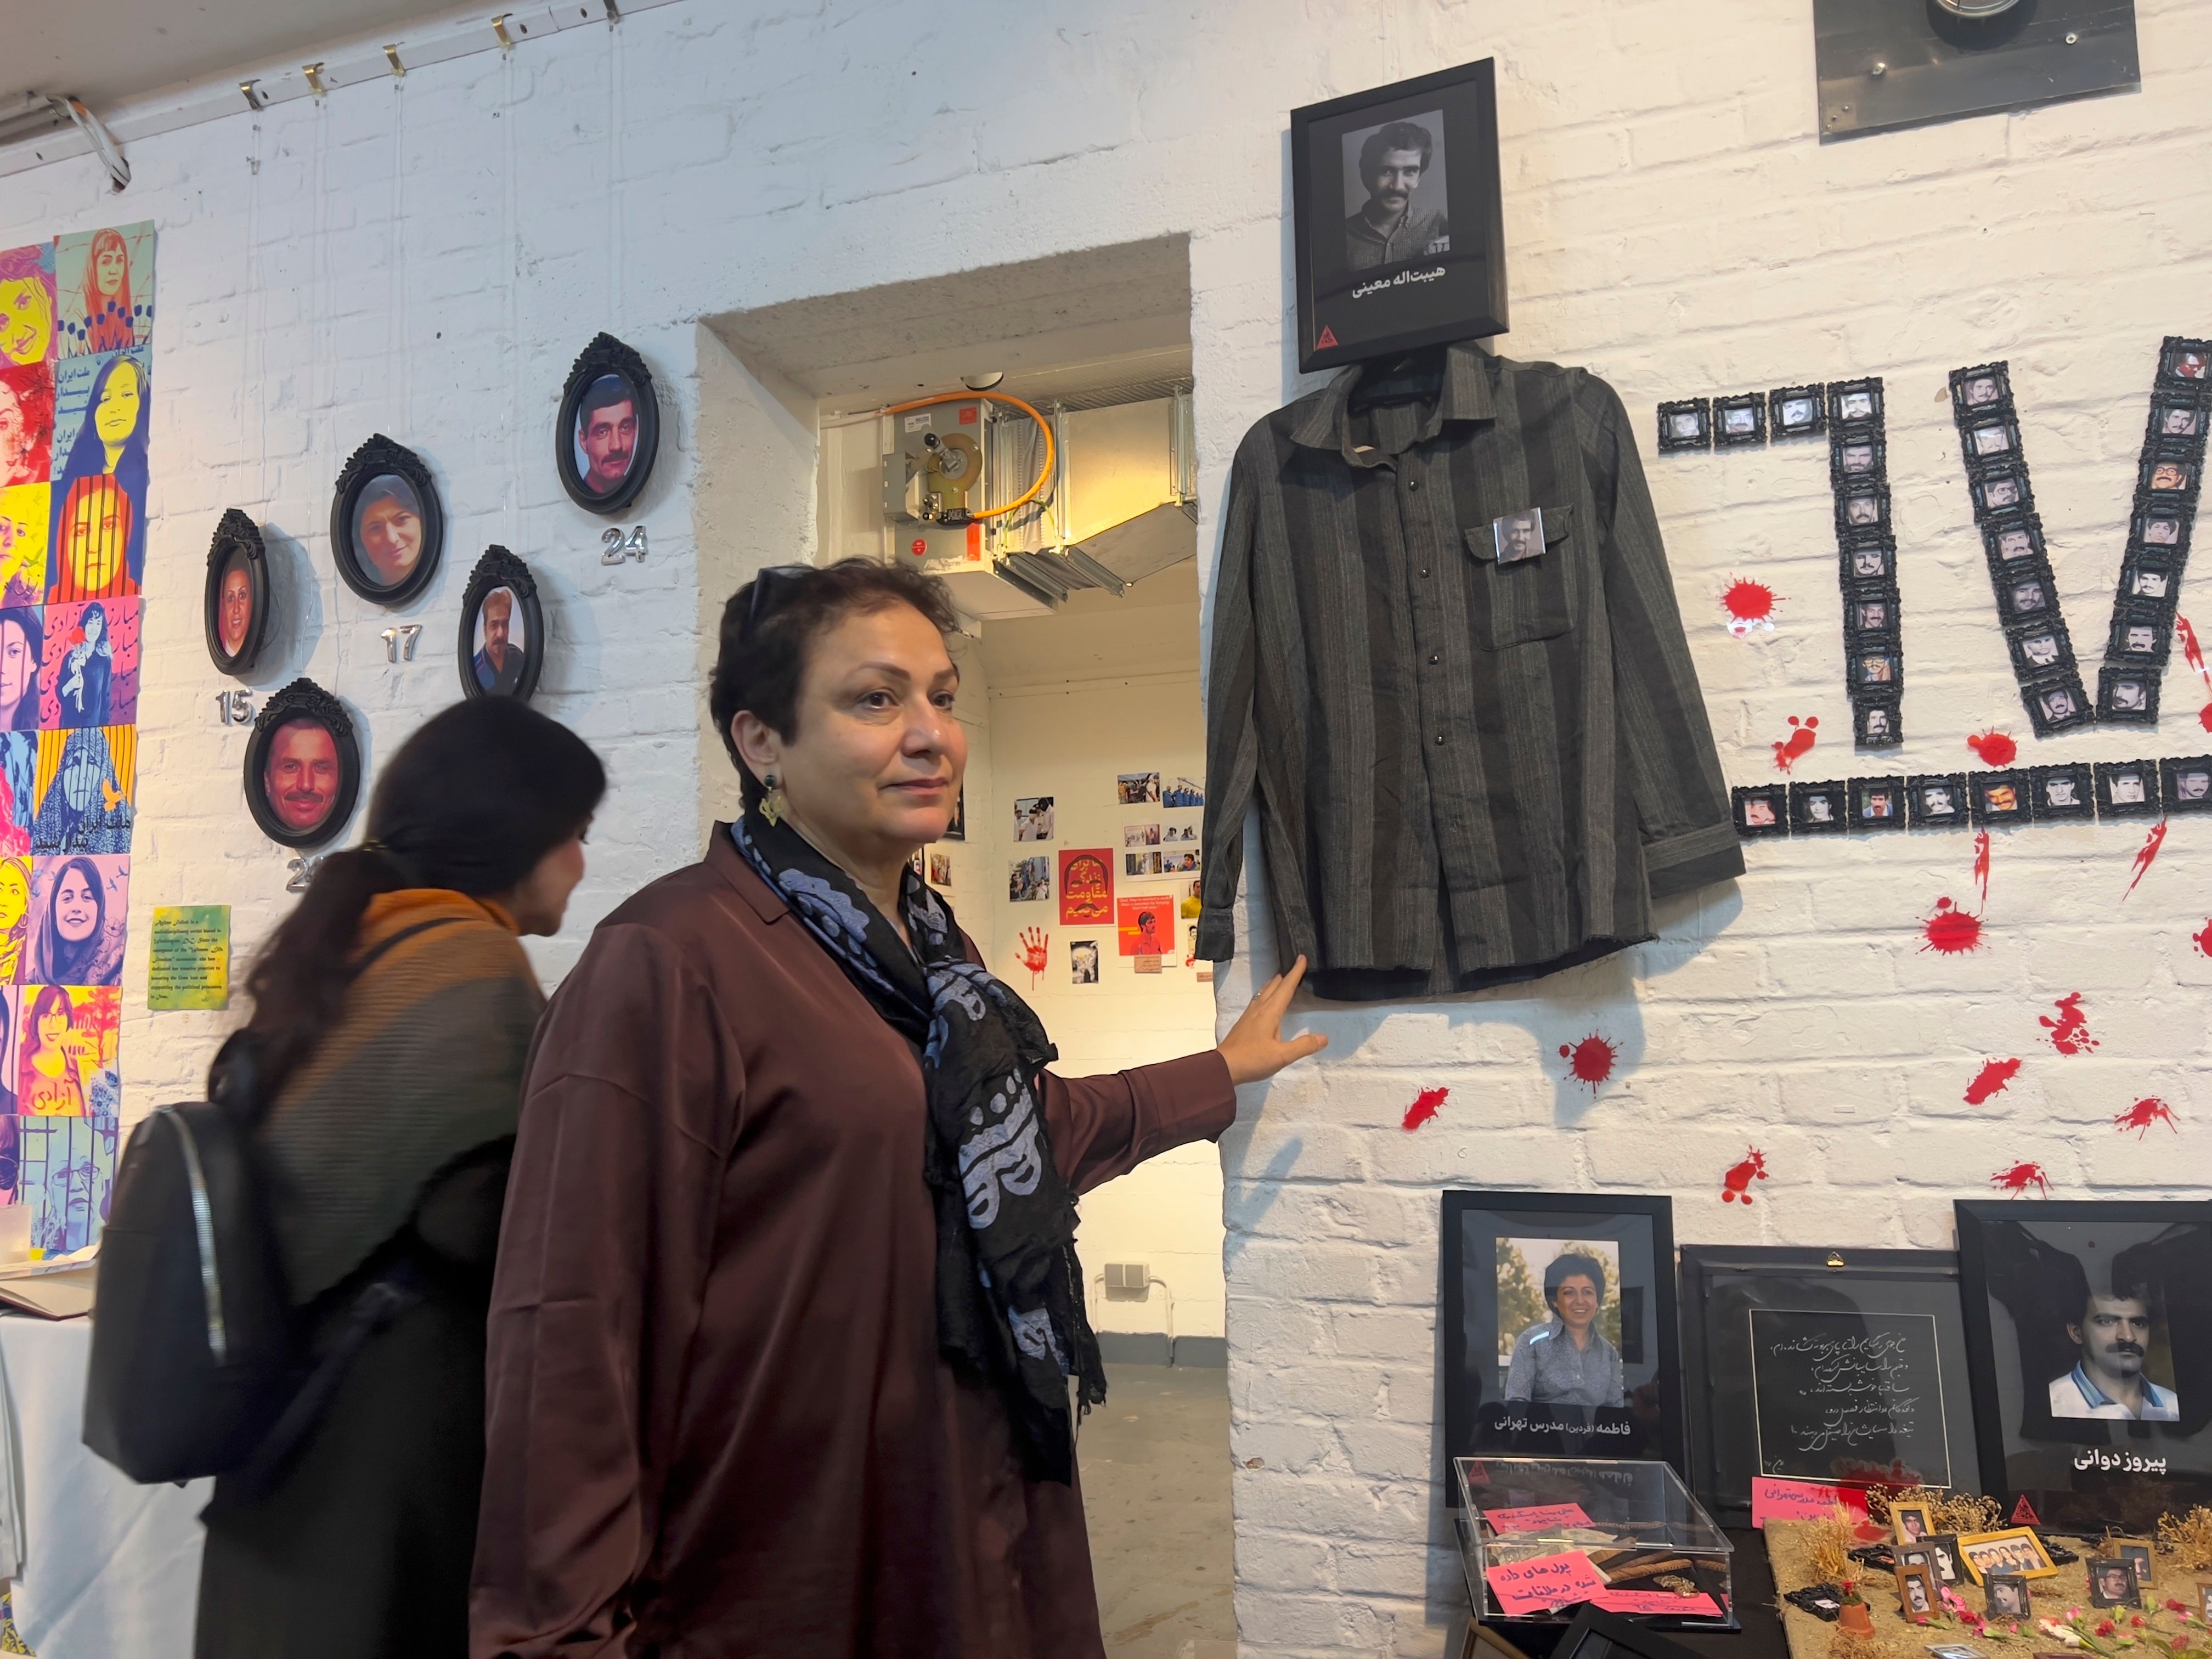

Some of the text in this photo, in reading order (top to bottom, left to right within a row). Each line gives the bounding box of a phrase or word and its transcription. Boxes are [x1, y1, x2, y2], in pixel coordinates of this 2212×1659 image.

[1352, 279, 1391, 298] معینی
[58, 369, 76, 384] ایران
[601, 526, 648, 566] 24
[381, 624, 422, 663] 17
[216, 689, 253, 724] 15
[32, 1079, 74, 1110] آزادی
[1494, 1416, 1631, 1435] فاطمه (فردین) مدرس تهرانی
[2074, 1448, 2167, 1475] پیروز دوانی
